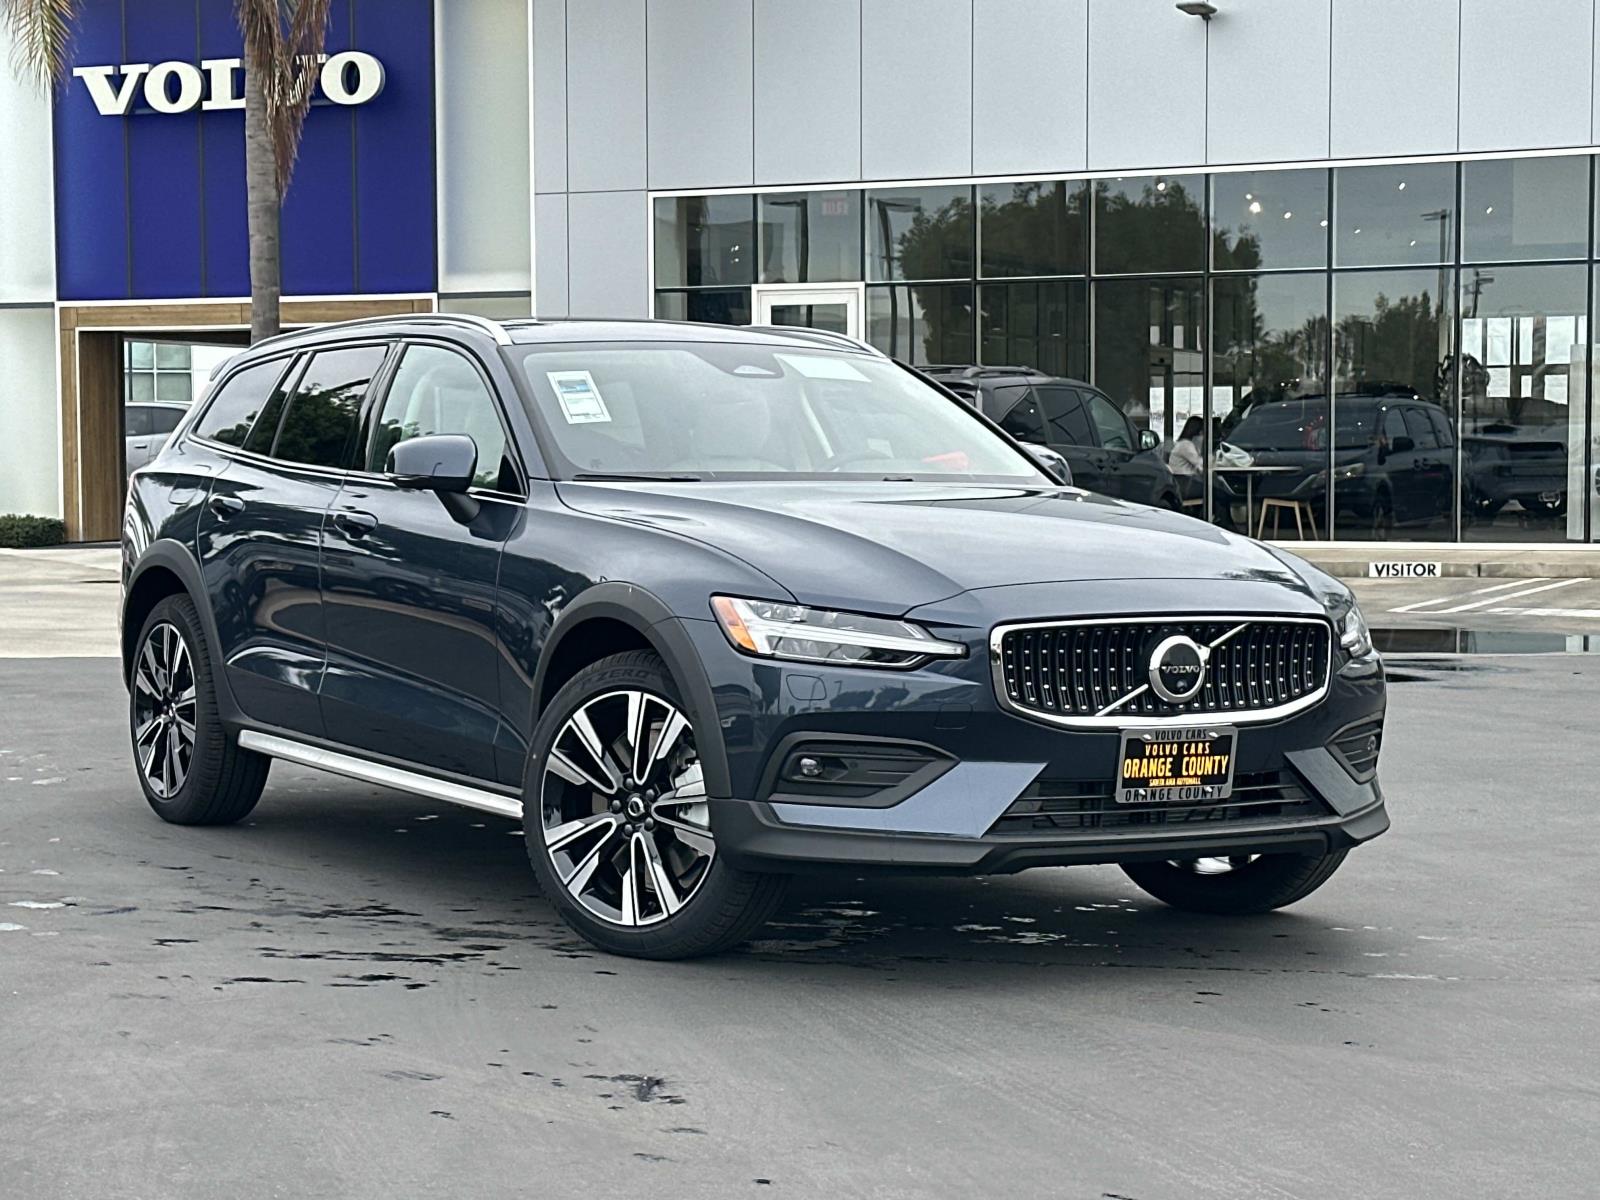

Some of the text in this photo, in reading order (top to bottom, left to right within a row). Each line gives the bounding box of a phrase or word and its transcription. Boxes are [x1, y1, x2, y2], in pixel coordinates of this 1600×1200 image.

[1374, 563, 1437, 577] VISITOR
[1161, 665, 1200, 674] VOLVO
[1155, 729, 1207, 741] VOLVO CARS
[1145, 742, 1211, 756] VOLVO CARS
[1124, 755, 1229, 778] ORANGE COUNTY
